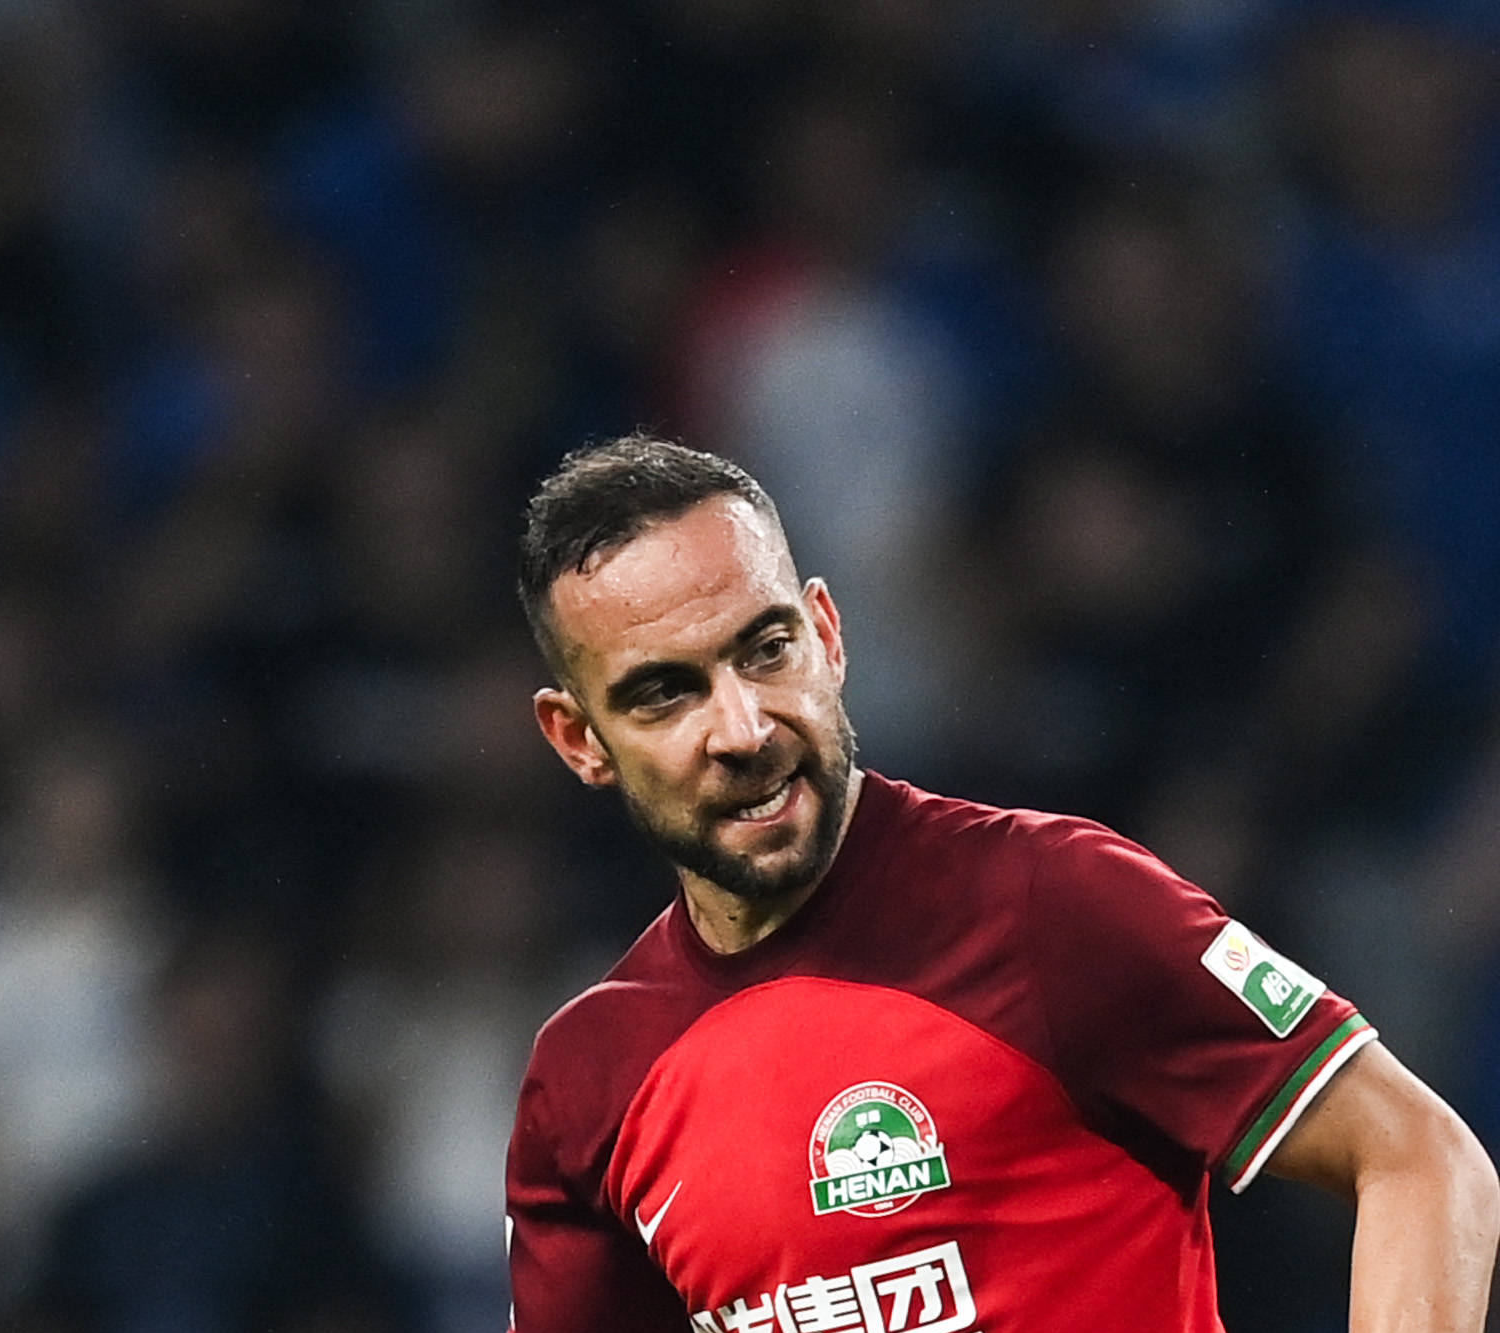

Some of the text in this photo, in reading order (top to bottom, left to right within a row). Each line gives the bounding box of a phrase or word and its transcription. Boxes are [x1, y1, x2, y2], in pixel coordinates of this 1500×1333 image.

[842, 1087, 898, 1110] FOOTBALL
[898, 1095, 926, 1124] CLUB
[826, 1160, 932, 1207] HENAN
